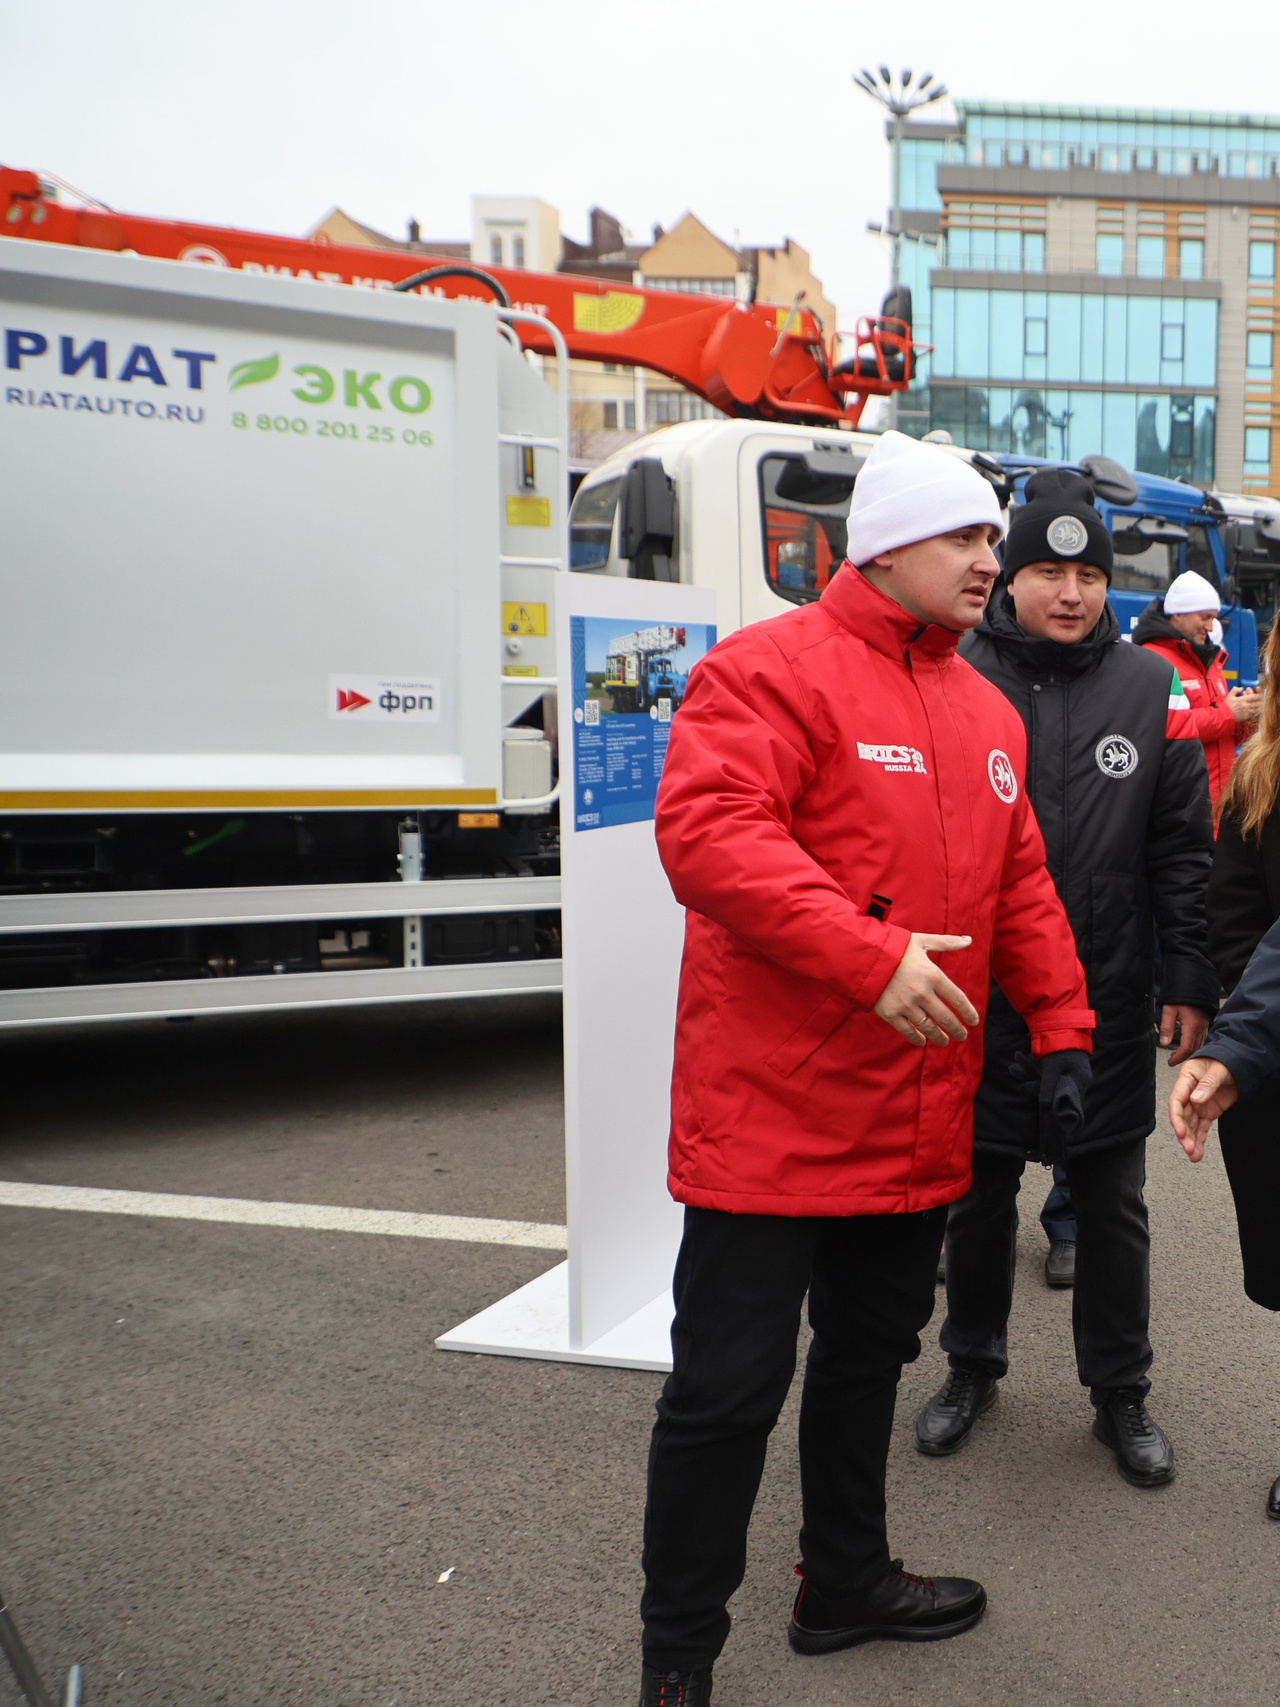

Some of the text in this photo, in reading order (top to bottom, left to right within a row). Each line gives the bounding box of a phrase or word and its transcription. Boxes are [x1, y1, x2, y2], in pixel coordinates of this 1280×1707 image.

[5, 328, 432, 414] РИАТ ЭКО
[5, 387, 205, 423] RIATAUTO.RU
[231, 411, 434, 447] 8 800 201 25 06
[856, 741, 911, 763] BRICS
[884, 764, 913, 772] RUSSIA
